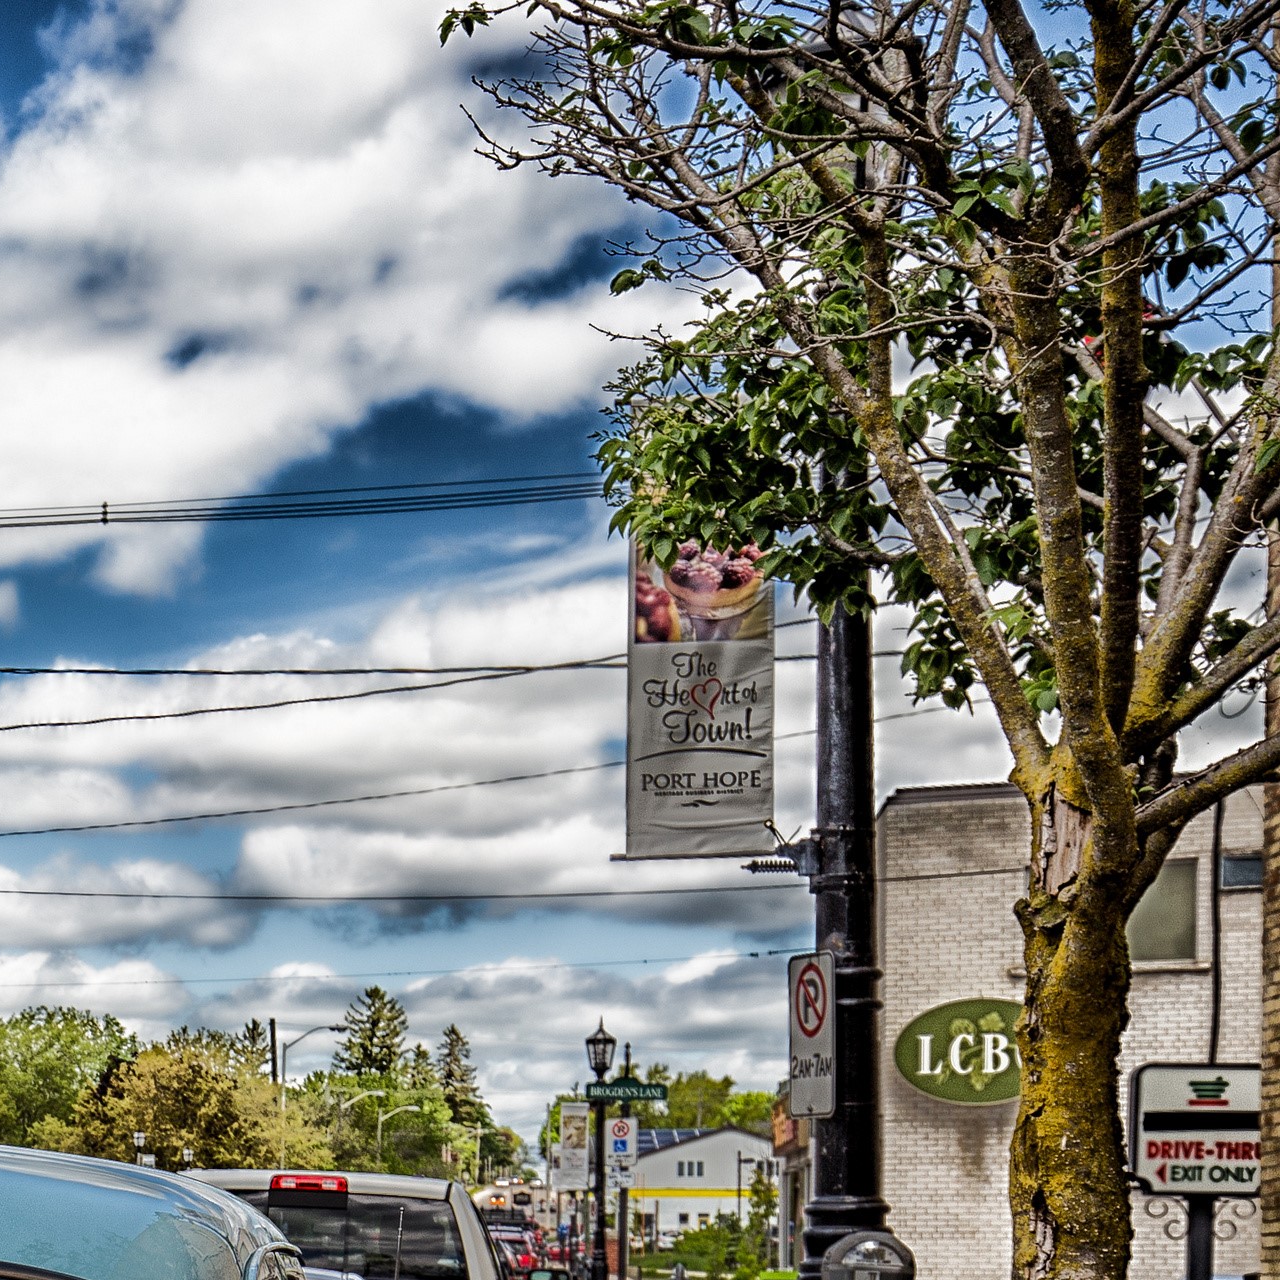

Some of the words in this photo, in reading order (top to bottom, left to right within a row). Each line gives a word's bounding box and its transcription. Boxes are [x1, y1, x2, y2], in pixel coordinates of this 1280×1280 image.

[672, 652, 717, 679] The
[742, 682, 757, 702] of
[663, 708, 754, 744] Town!
[641, 773, 696, 792] PORT
[703, 770, 762, 789] HOPE
[916, 1033, 1022, 1075] LCB
[590, 1086, 638, 1097] BROGDEN'S
[640, 1087, 663, 1097] LANE
[1170, 1165, 1204, 1182] EXIT
[1209, 1165, 1257, 1183] ONLY
